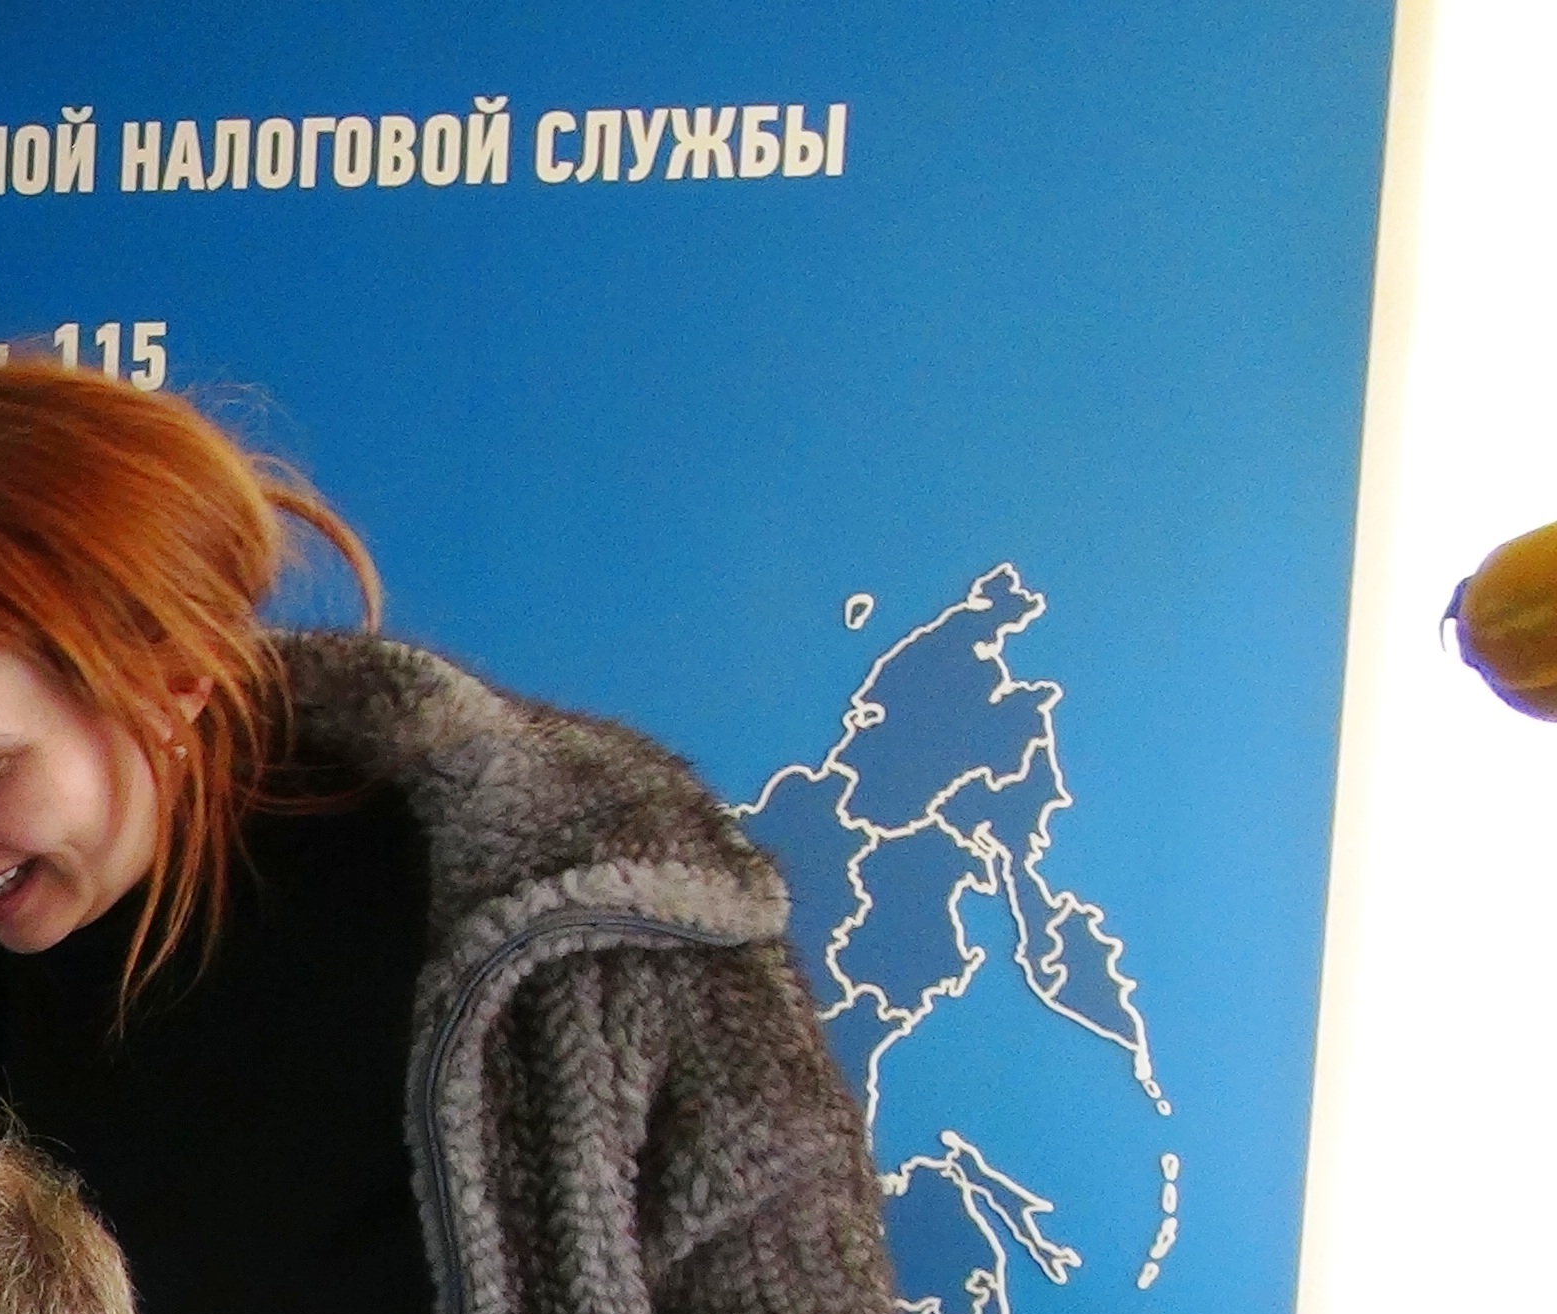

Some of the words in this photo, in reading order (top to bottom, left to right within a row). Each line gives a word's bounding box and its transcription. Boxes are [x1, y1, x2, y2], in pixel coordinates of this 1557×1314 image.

[120, 95, 511, 192] НАЛОГОВОЙ
[535, 103, 847, 184] СЛУЖБЫ
[52, 321, 167, 393] 115
